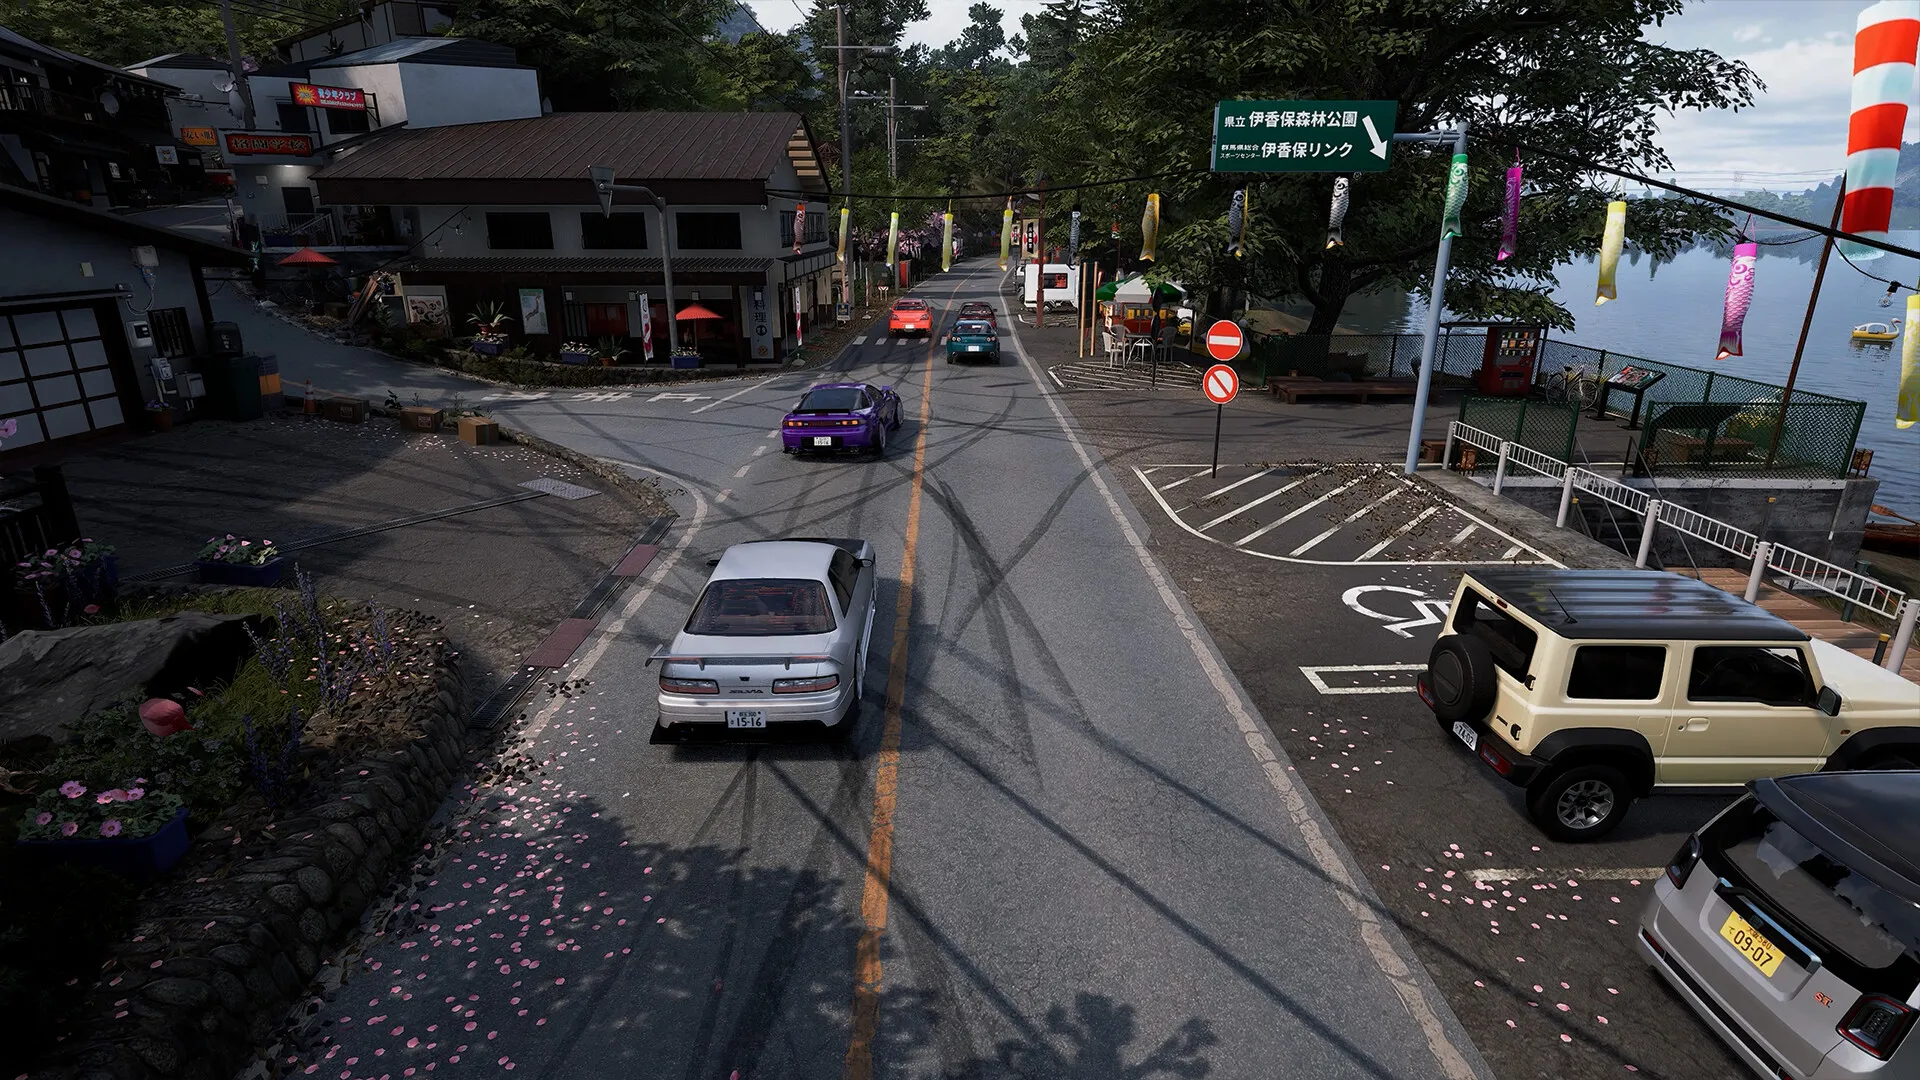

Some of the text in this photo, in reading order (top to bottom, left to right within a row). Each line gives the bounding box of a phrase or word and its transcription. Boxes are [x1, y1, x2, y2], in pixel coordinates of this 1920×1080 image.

[1224, 111, 1358, 128] 県立 伊香保森林公園
[1261, 141, 1353, 158] 伊香保リンク
[737, 717, 762, 727] 15-16
[1733, 930, 1773, 967] 09-07
